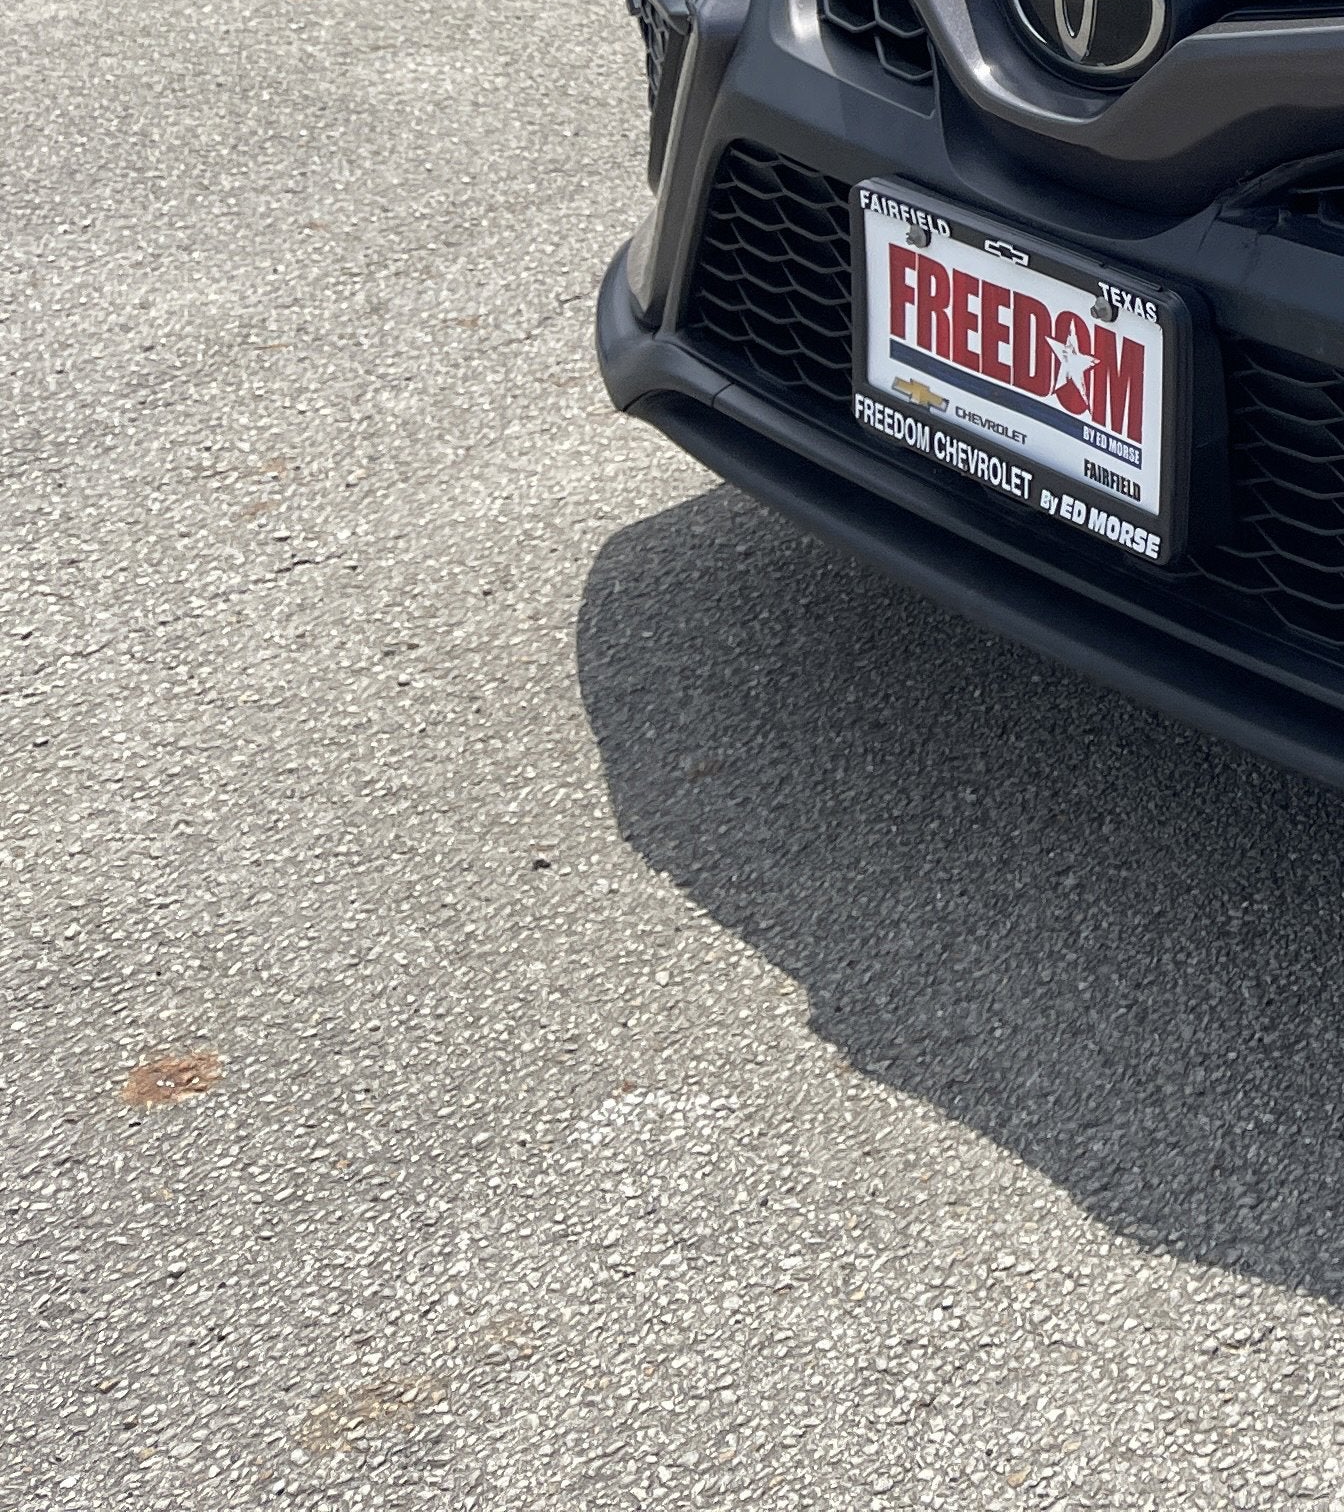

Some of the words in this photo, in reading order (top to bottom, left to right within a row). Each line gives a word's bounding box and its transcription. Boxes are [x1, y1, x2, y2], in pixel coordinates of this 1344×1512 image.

[859, 189, 951, 238] FAIRFIELD
[1098, 281, 1158, 323] TEXAS
[888, 242, 1145, 445] FREEDOM
[954, 405, 1028, 445] CHEVROLET
[1082, 425, 1096, 443] BY
[1096, 431, 1108, 448] ED
[1108, 440, 1140, 465] MORSE
[854, 393, 931, 453] FREEDOM
[933, 431, 1033, 500] CHEVROLET
[1040, 489, 1059, 516] By
[1060, 494, 1087, 525] ED
[1087, 506, 1161, 559] MORSE
[1083, 458, 1142, 502] FAIRFIELD
